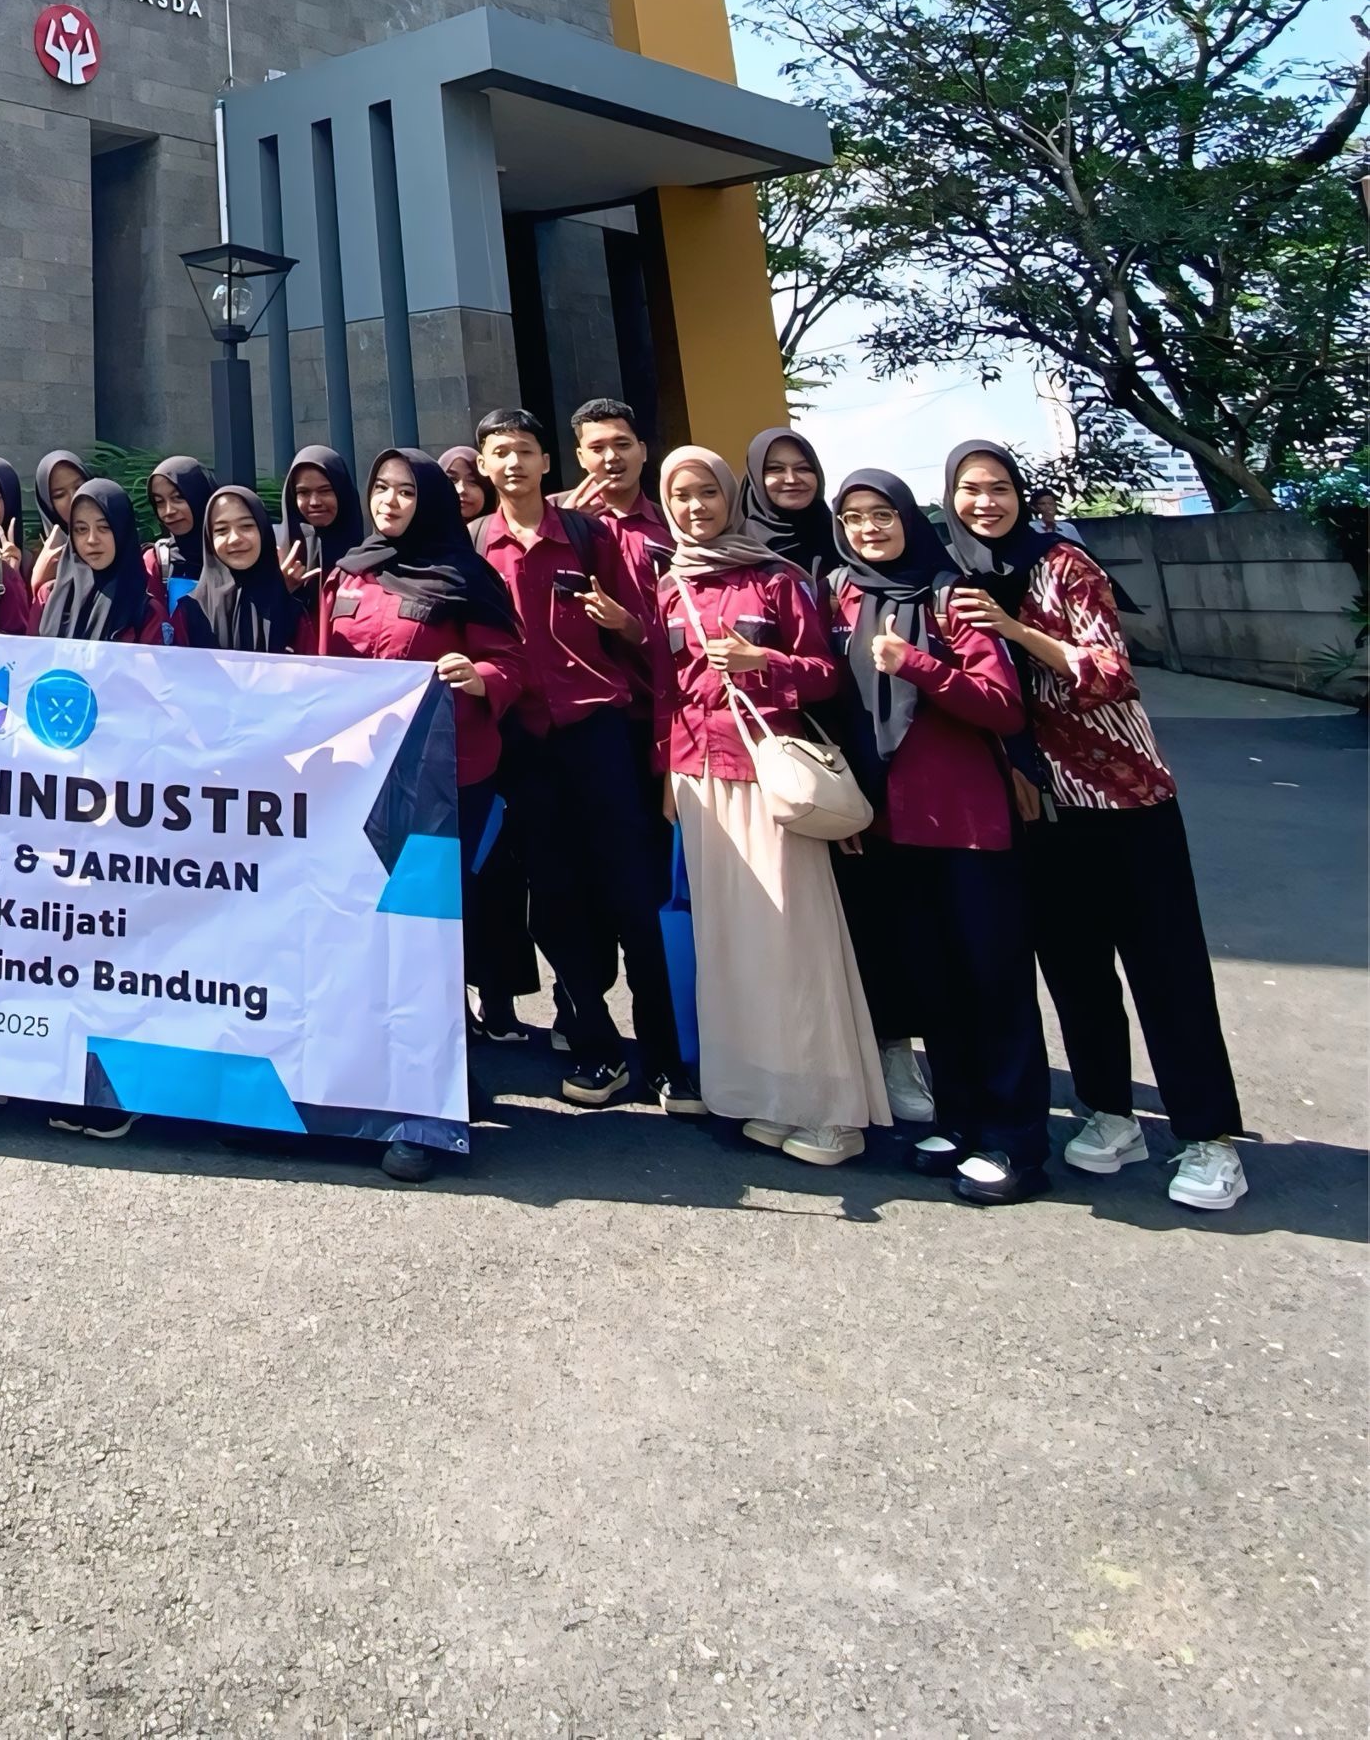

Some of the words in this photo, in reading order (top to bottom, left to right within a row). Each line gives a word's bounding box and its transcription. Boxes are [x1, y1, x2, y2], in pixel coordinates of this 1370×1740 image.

[13, 843, 40, 874] &
[52, 847, 259, 893] JARINGAN
[93, 959, 269, 1021] Bandung
